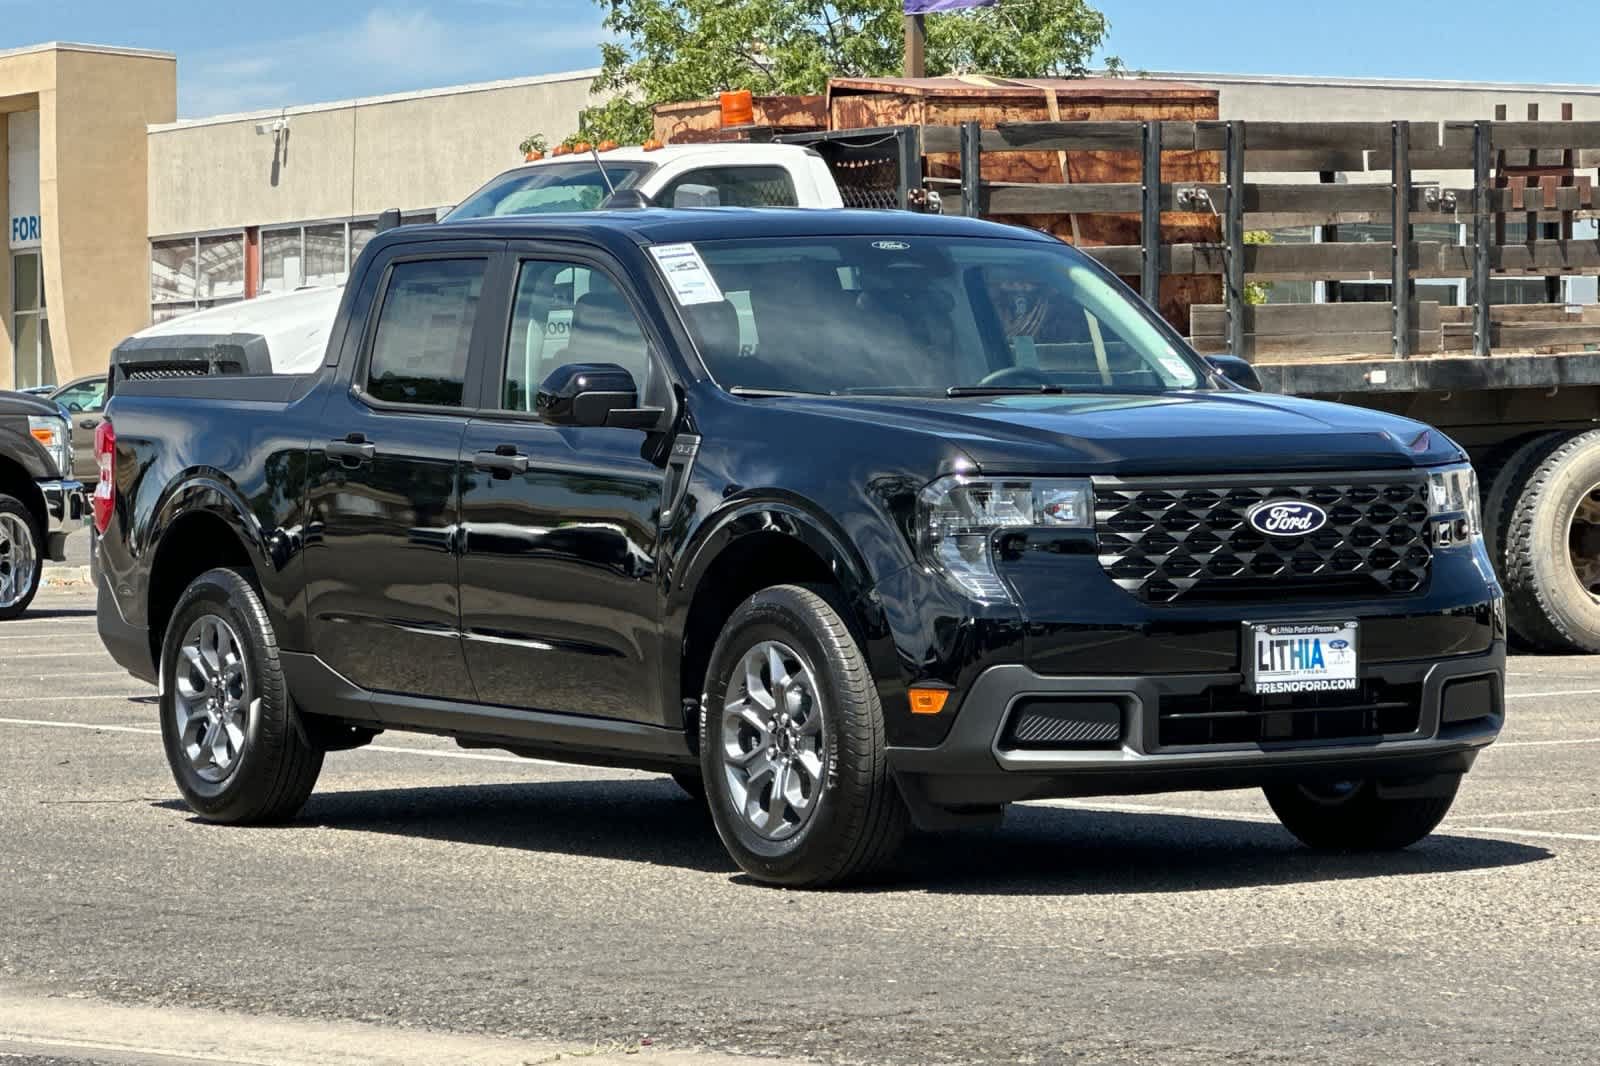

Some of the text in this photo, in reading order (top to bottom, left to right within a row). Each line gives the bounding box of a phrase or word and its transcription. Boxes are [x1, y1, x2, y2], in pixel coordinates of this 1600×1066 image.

[12, 215, 41, 242] FOR
[1265, 506, 1313, 530] Ford
[1258, 638, 1325, 671] LITHIA
[1255, 679, 1356, 694] FRESNOFORD.COM
